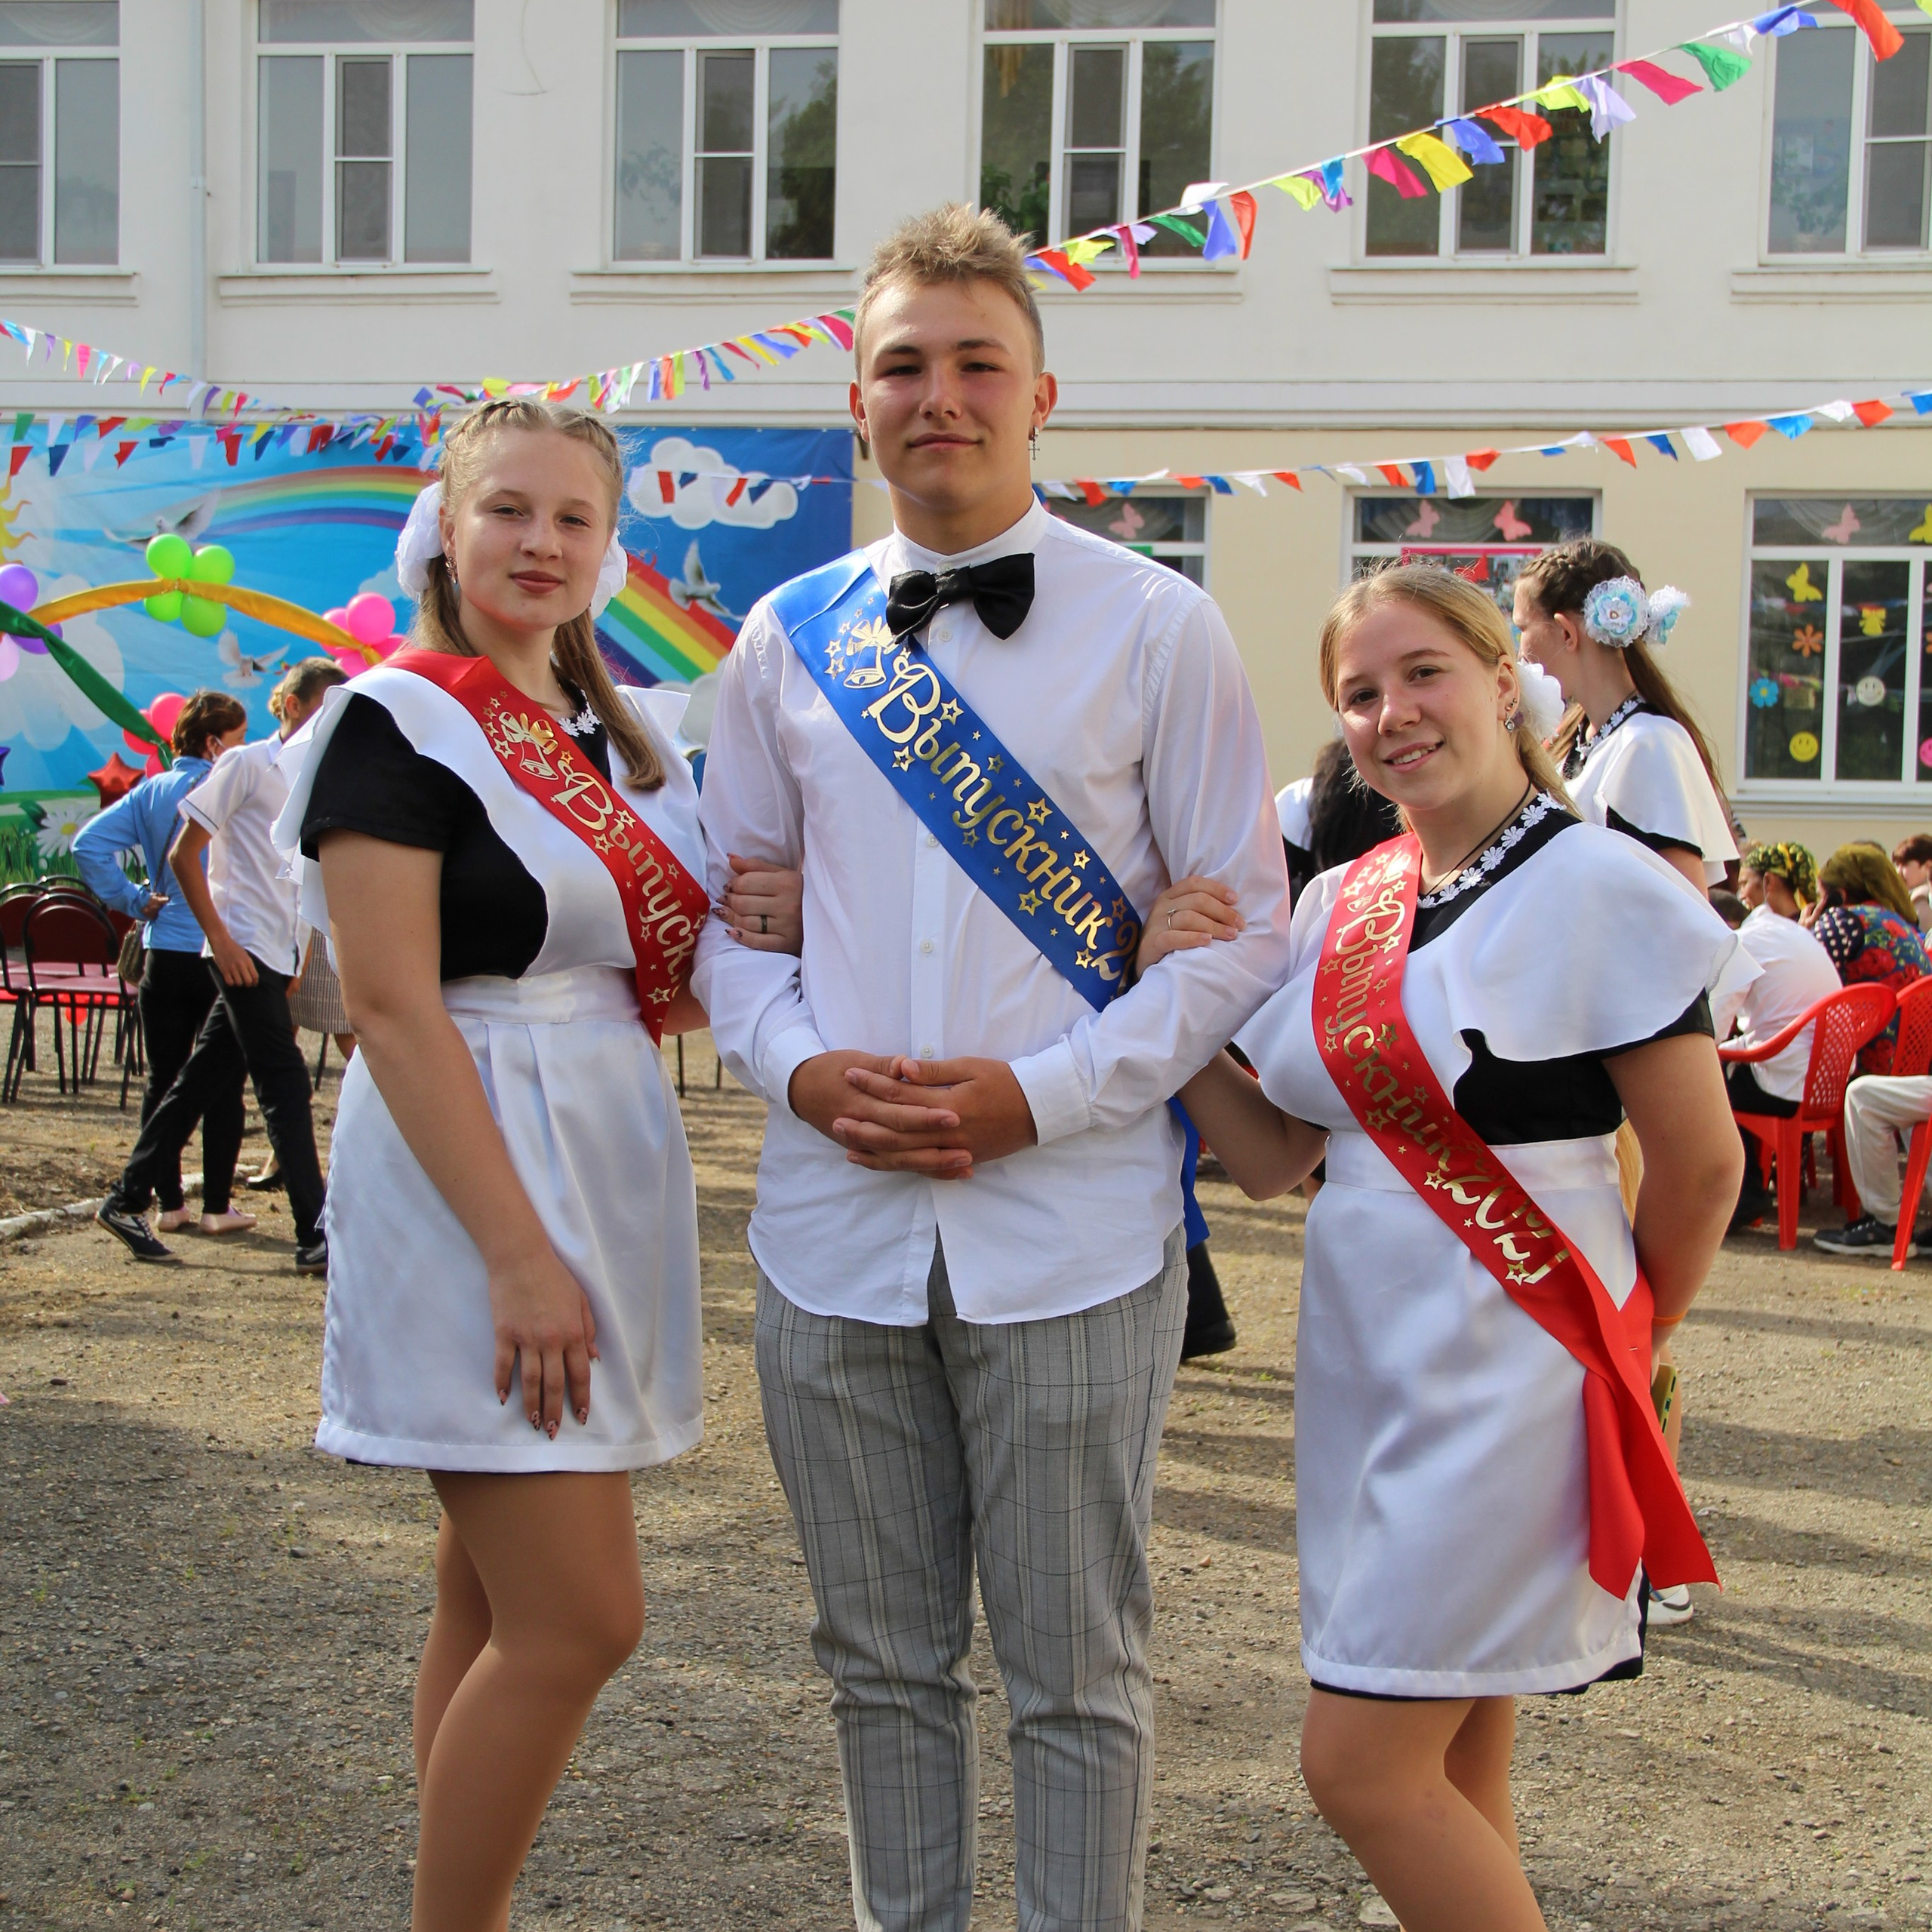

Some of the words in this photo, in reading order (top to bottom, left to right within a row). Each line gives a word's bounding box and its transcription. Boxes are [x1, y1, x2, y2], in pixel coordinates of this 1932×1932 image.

[555, 759, 696, 998] Выпуск
[867, 655, 1113, 950] Выпускник
[1324, 888, 1451, 1172] Выпускник
